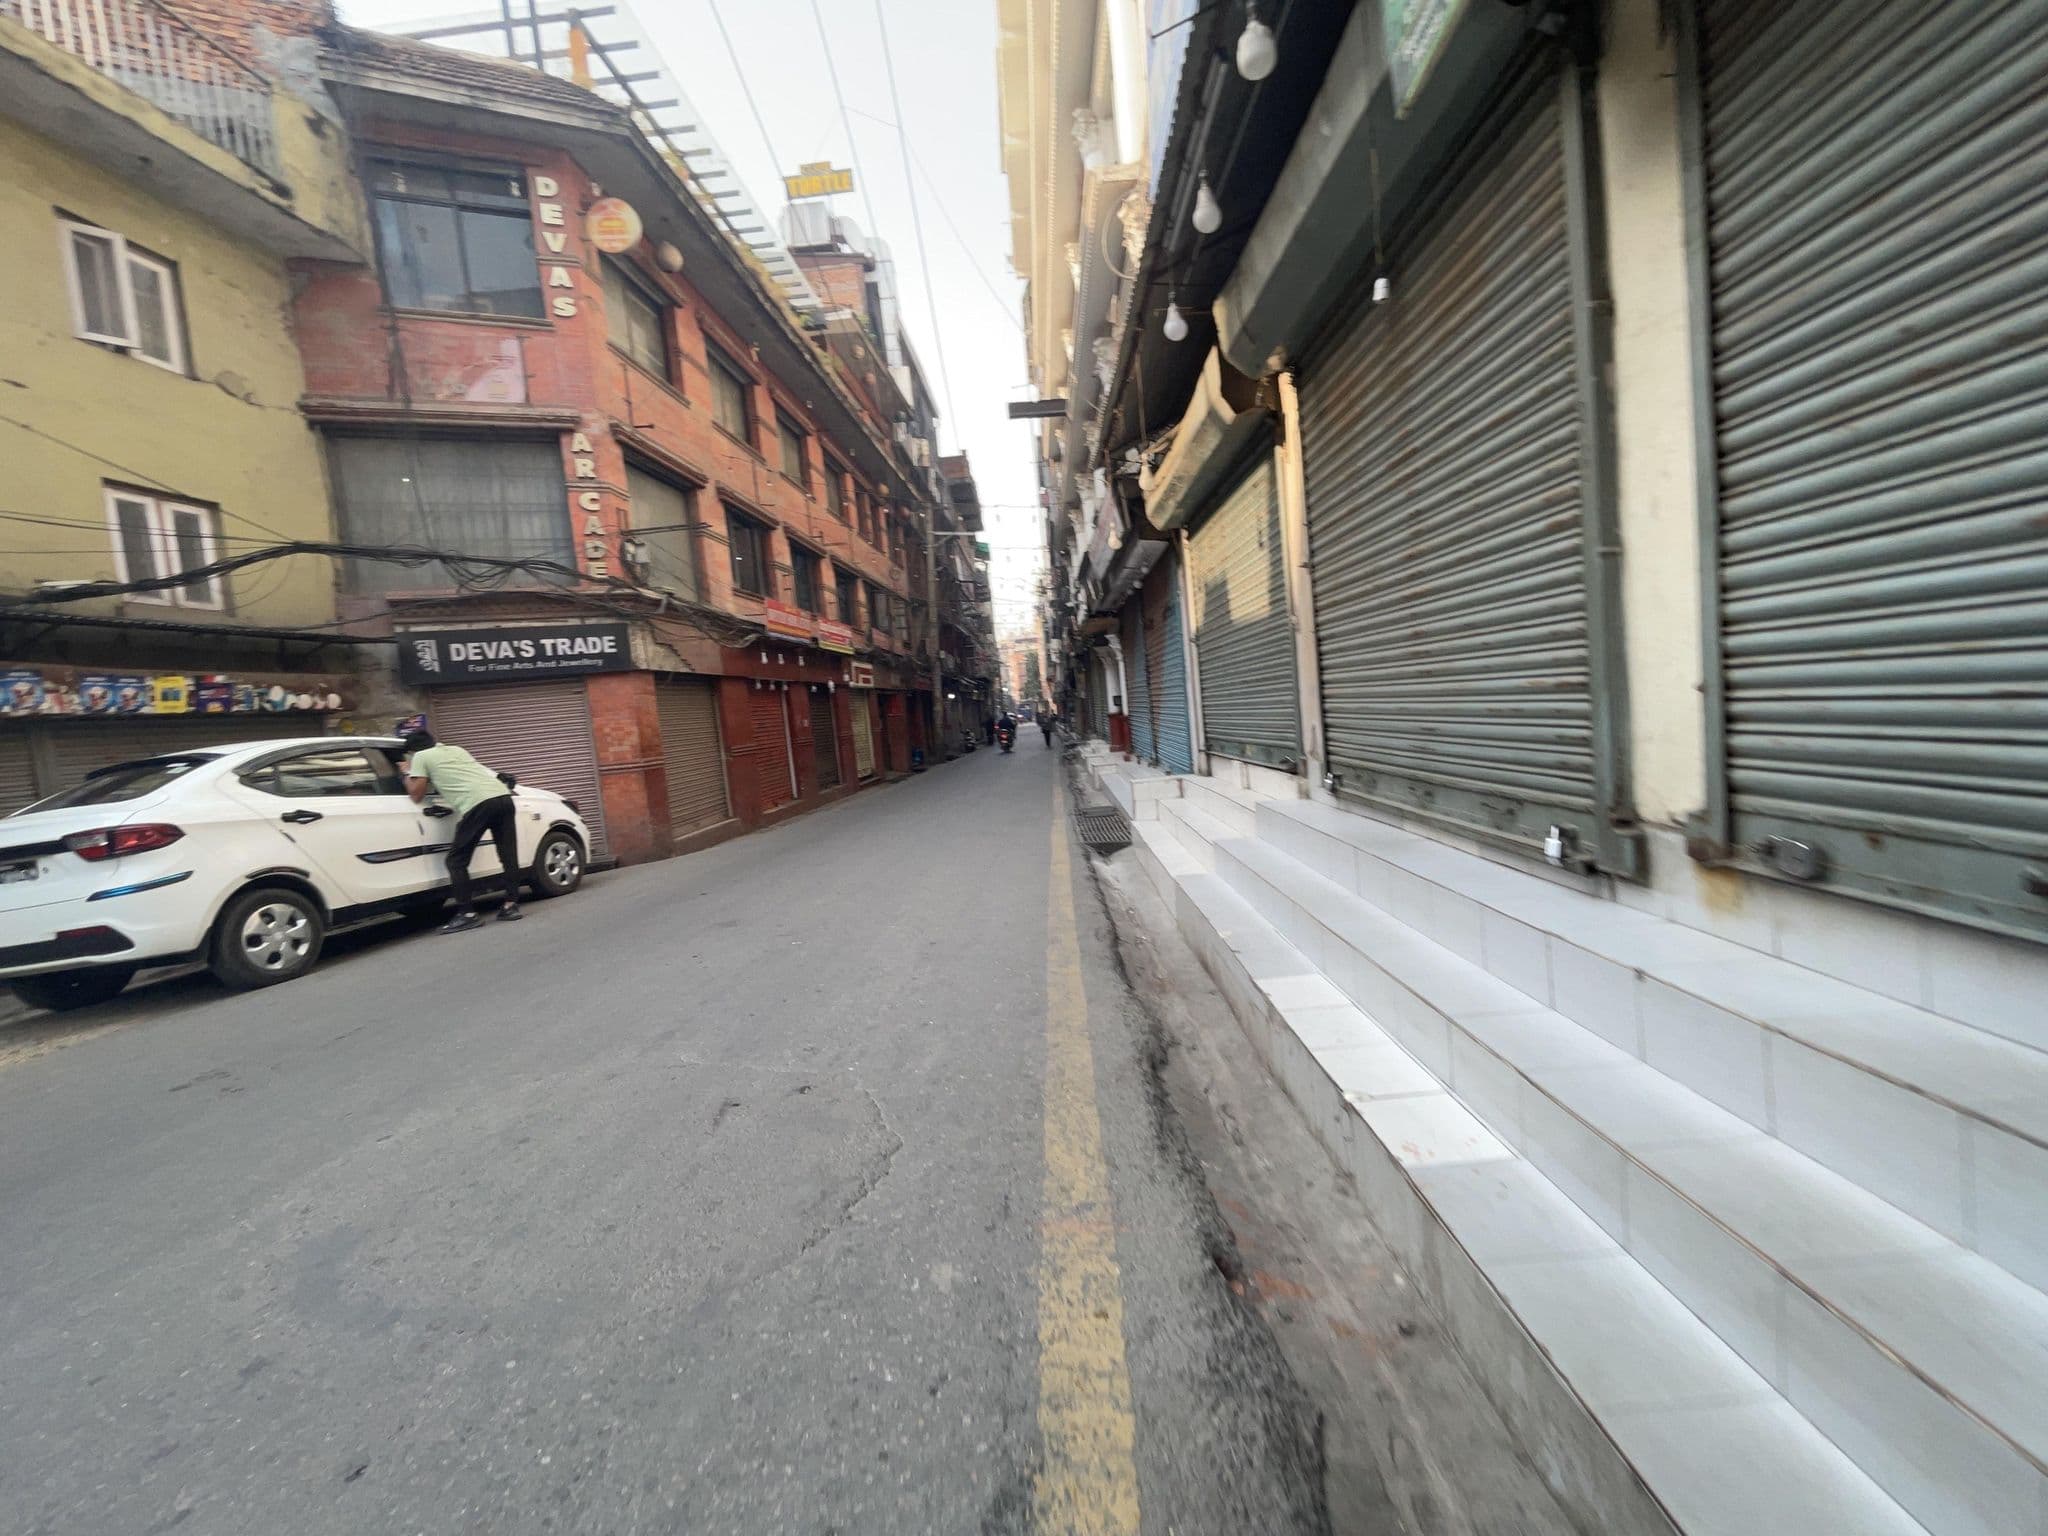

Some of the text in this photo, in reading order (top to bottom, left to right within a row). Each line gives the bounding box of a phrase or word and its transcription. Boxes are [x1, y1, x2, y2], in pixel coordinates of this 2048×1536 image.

[534, 175, 578, 317] DEVAS
[570, 432, 609, 578] ARCADE
[448, 638, 536, 662] DEVA'S
[539, 635, 618, 657] TRADE
[467, 664, 487, 672] For
[488, 663, 511, 671] Fine
[512, 661, 534, 670] Arts
[535, 660, 557, 668] And
